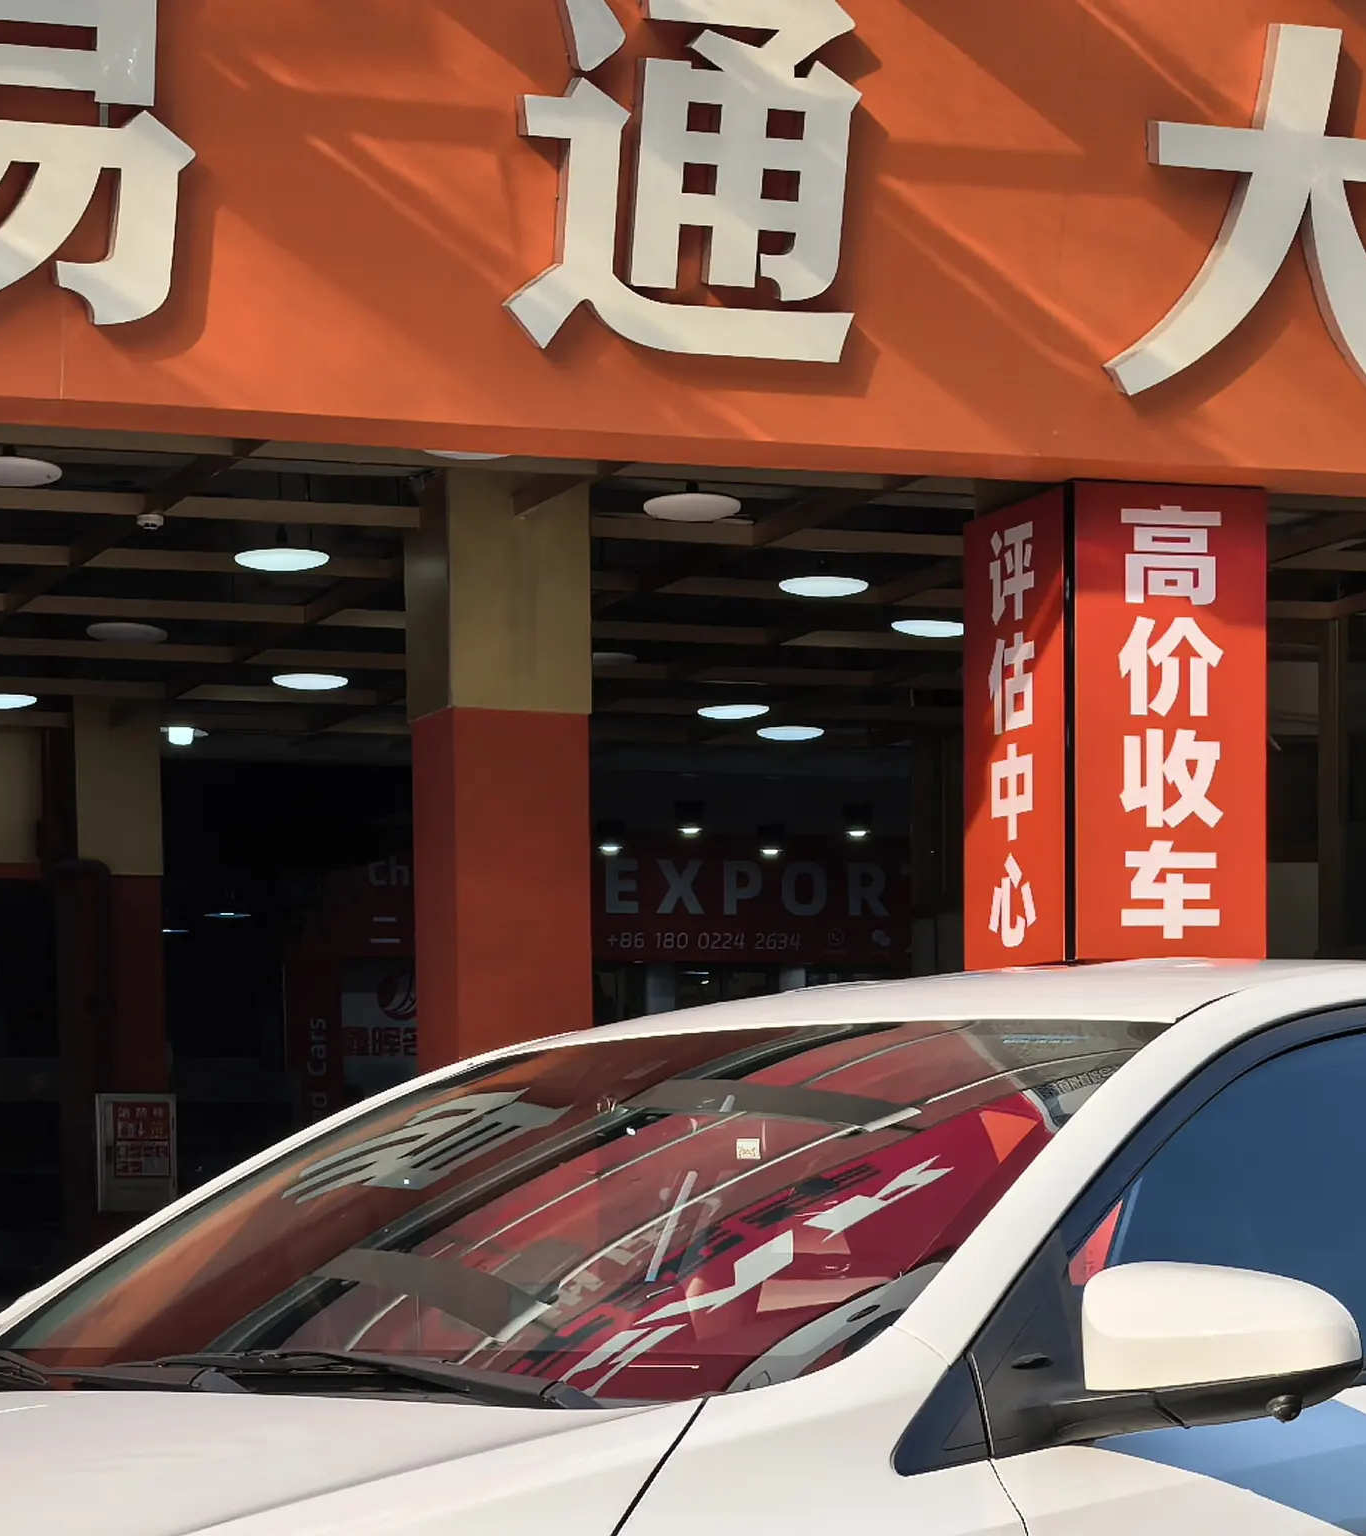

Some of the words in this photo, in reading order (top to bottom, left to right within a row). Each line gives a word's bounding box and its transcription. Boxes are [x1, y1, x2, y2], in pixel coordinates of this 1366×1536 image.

[987, 519, 1037, 949] 评估中心
[1117, 504, 1225, 940] 高价收车
[605, 858, 911, 918] EXPOR
[606, 931, 646, 950] +86
[654, 931, 689, 951] 180
[696, 931, 745, 951] 0224
[306, 1016, 328, 1077] Cars
